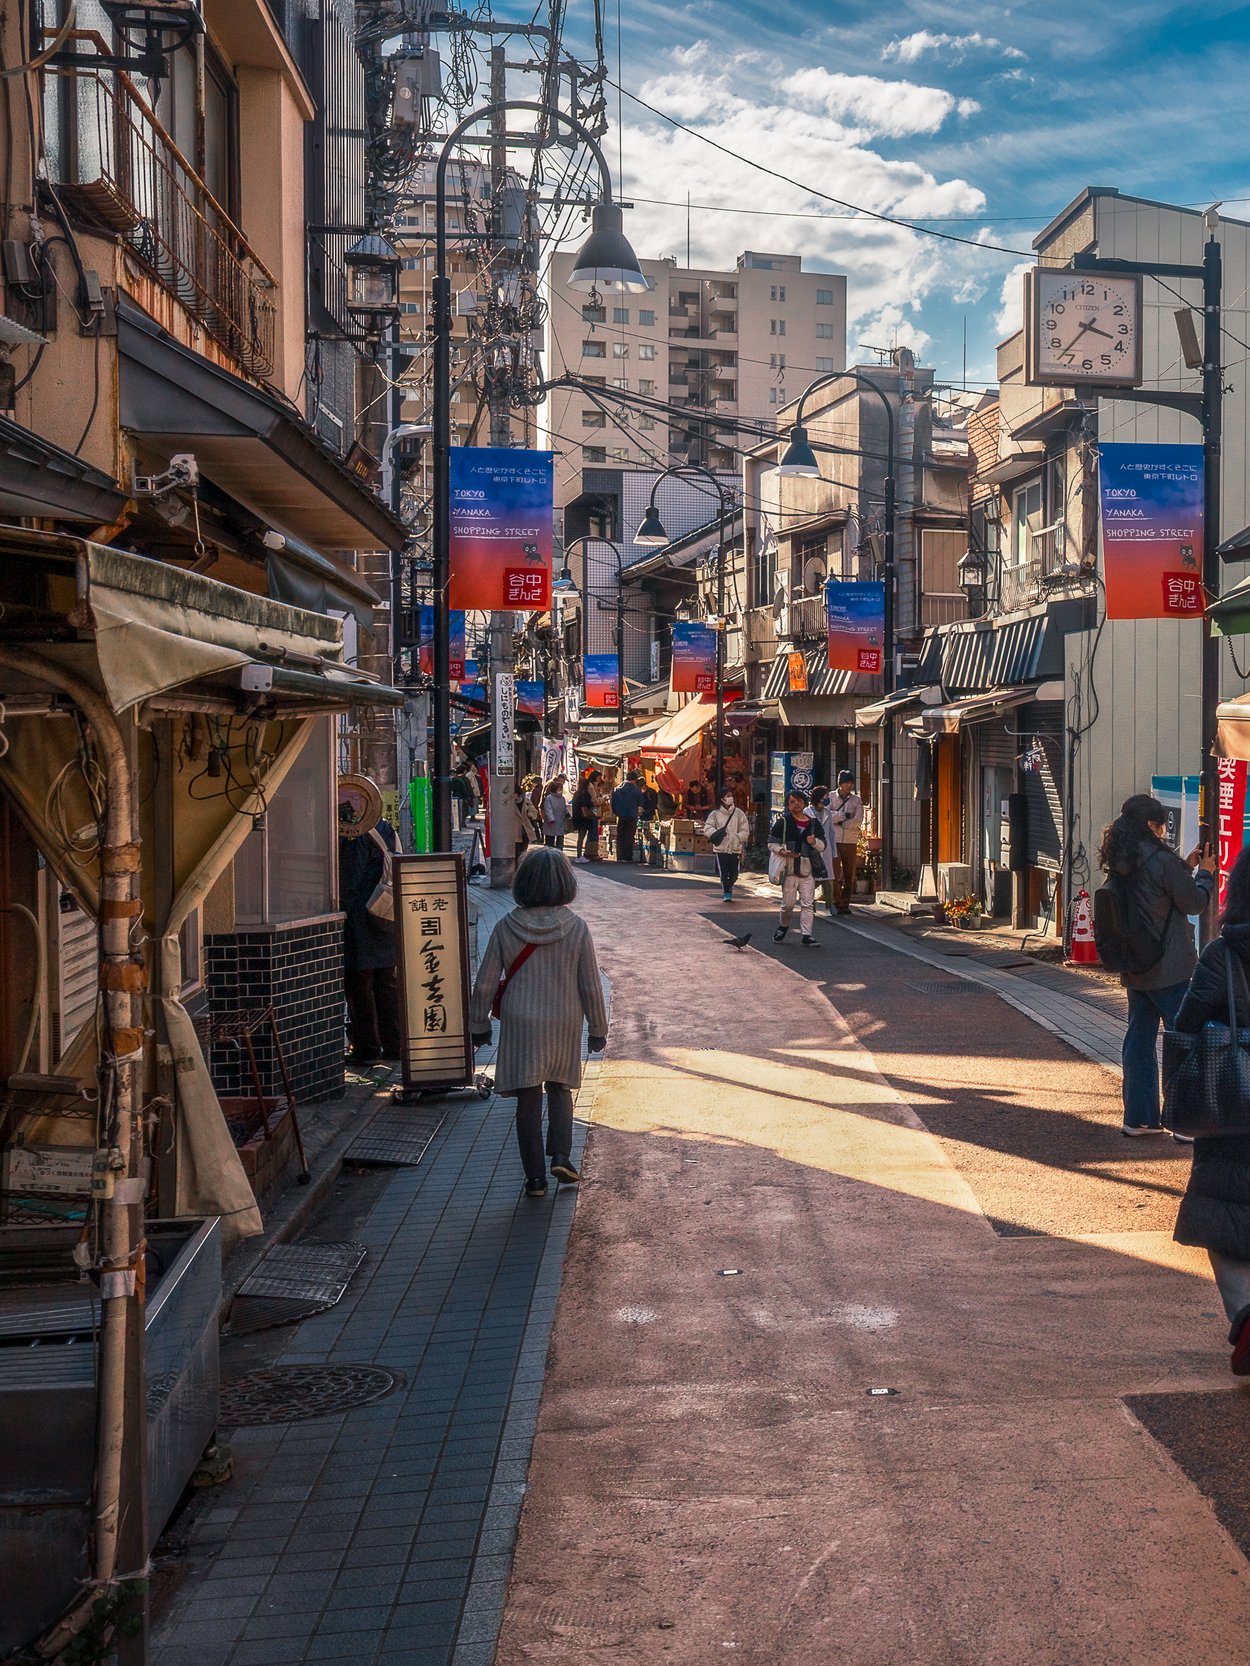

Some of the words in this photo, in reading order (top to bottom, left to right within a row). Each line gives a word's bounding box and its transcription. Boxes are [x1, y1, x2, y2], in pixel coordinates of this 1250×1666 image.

[1081, 285, 1095, 295] 12
[1063, 290, 1075, 301] 11
[1103, 290, 1108, 301] 1
[1050, 304, 1065, 314] 10
[1113, 305, 1124, 316] 2
[1046, 320, 1057, 330] 9
[1118, 324, 1129, 335] 3
[1051, 338, 1062, 348] 8
[1114, 340, 1124, 352] 4
[1065, 354, 1075, 364] 7
[1101, 355, 1111, 365] 5
[1082, 359, 1093, 370] 6
[1143, 473, 1198, 481] 東京下町レトロ
[454, 489, 485, 498] TOKYO
[1105, 489, 1136, 497] TOKYO
[453, 508, 491, 517] YANAKA
[1106, 509, 1144, 517] YANAKA
[453, 527, 501, 535] SHOPPING
[505, 528, 540, 536] STREET
[1106, 529, 1156, 537] SHOPPING
[1160, 529, 1195, 537] STREET
[509, 573, 541, 587] 谷中
[1168, 578, 1195, 593] 谷中
[509, 588, 542, 601] ぎんざ
